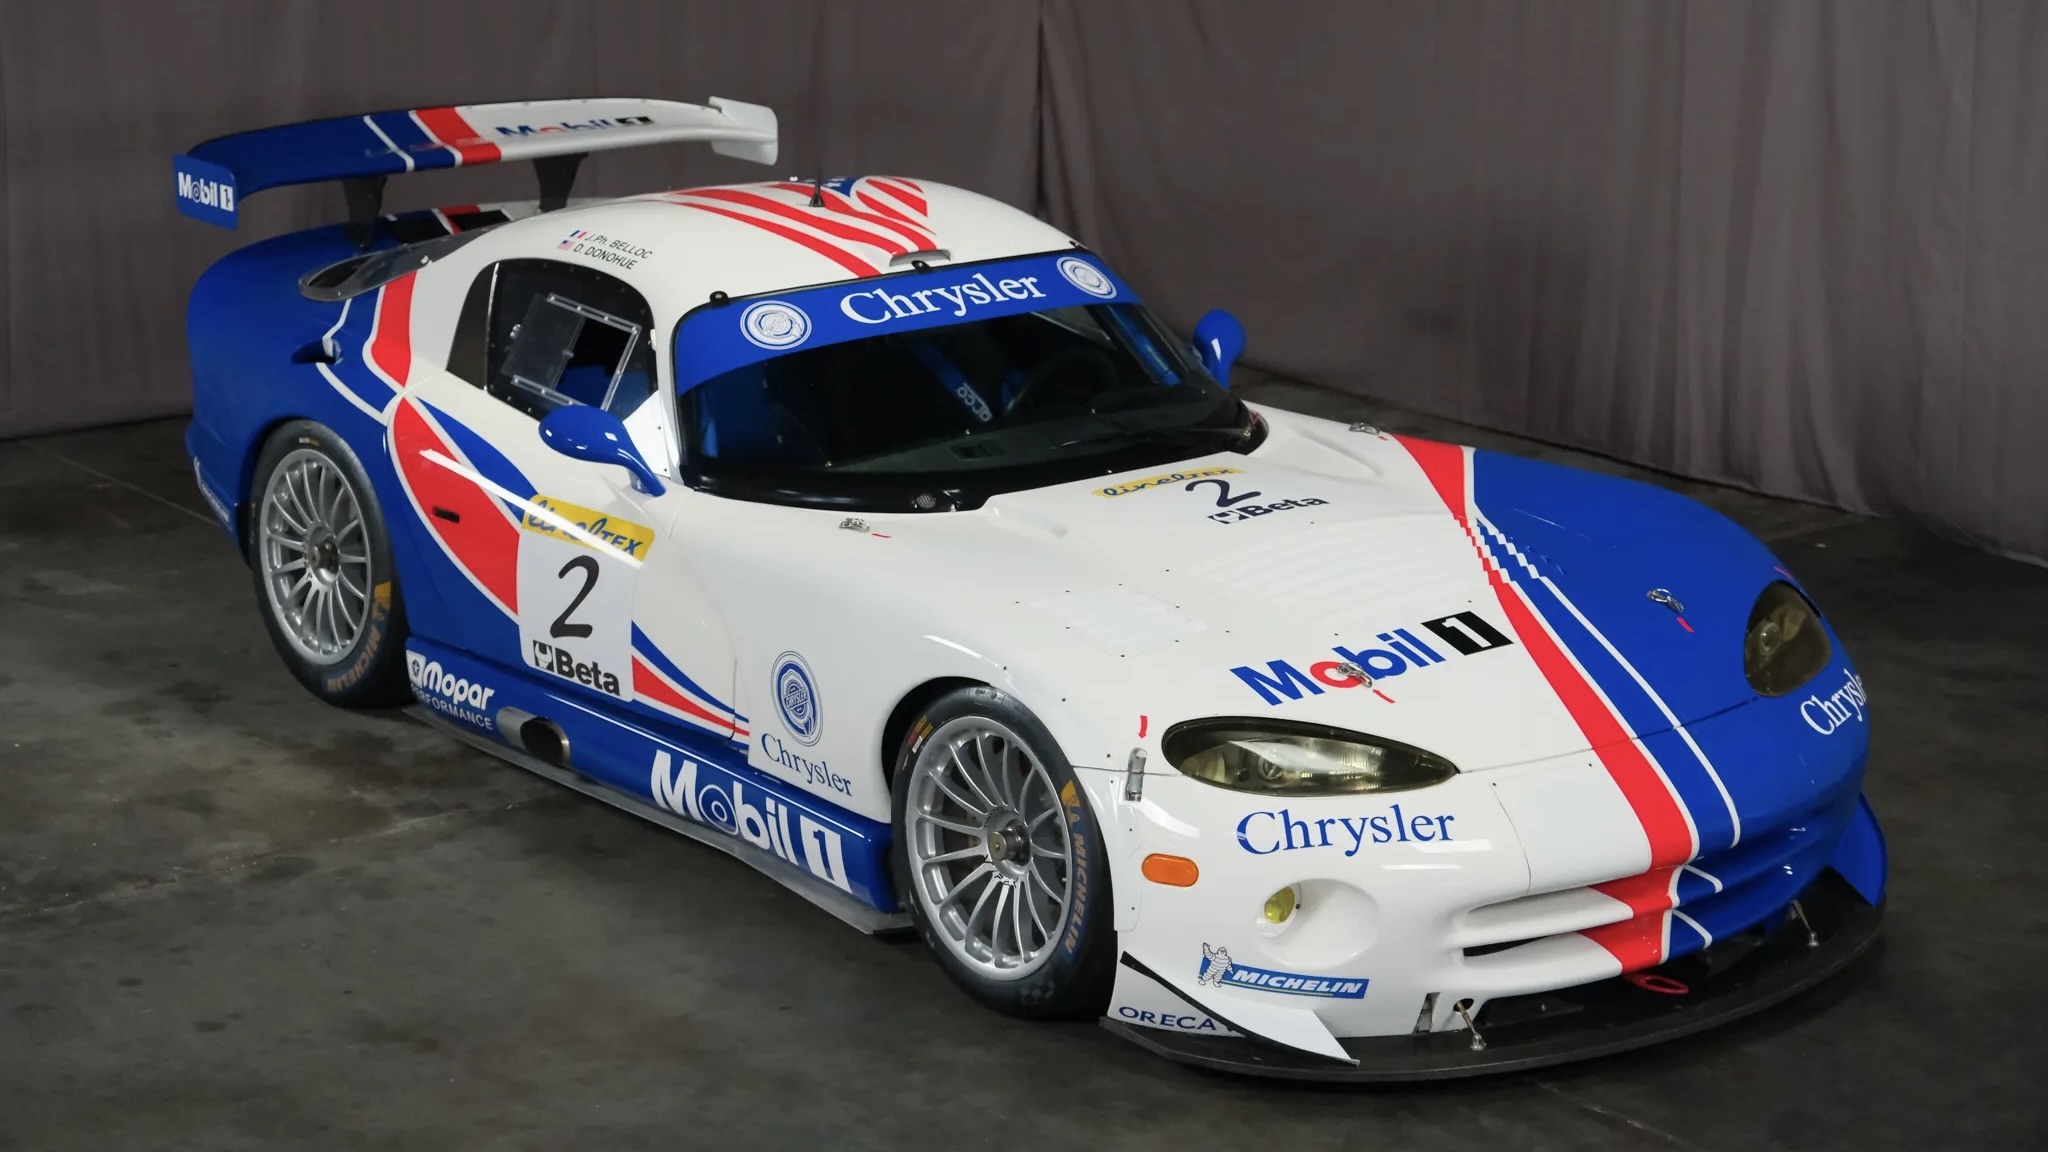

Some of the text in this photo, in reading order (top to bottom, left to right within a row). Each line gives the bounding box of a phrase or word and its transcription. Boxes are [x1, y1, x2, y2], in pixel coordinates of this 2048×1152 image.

[178, 172, 218, 207] Mobil
[573, 243, 638, 270] D. DONOHUE
[609, 239, 653, 259] BELLOC
[840, 272, 1047, 325] Chrysler
[1185, 479, 1262, 508] 2
[1235, 498, 1330, 517] Beta
[549, 555, 600, 639] 2
[555, 648, 620, 696] Beta
[1229, 628, 1447, 706] Mobil
[761, 733, 853, 797] Chrysler
[651, 749, 799, 866] Mobil
[1236, 803, 1455, 857] Chrysler
[1064, 833, 1088, 953] MICHELIN
[1232, 969, 1363, 994] MICHELIN
[1119, 1006, 1217, 1031] ORECA
